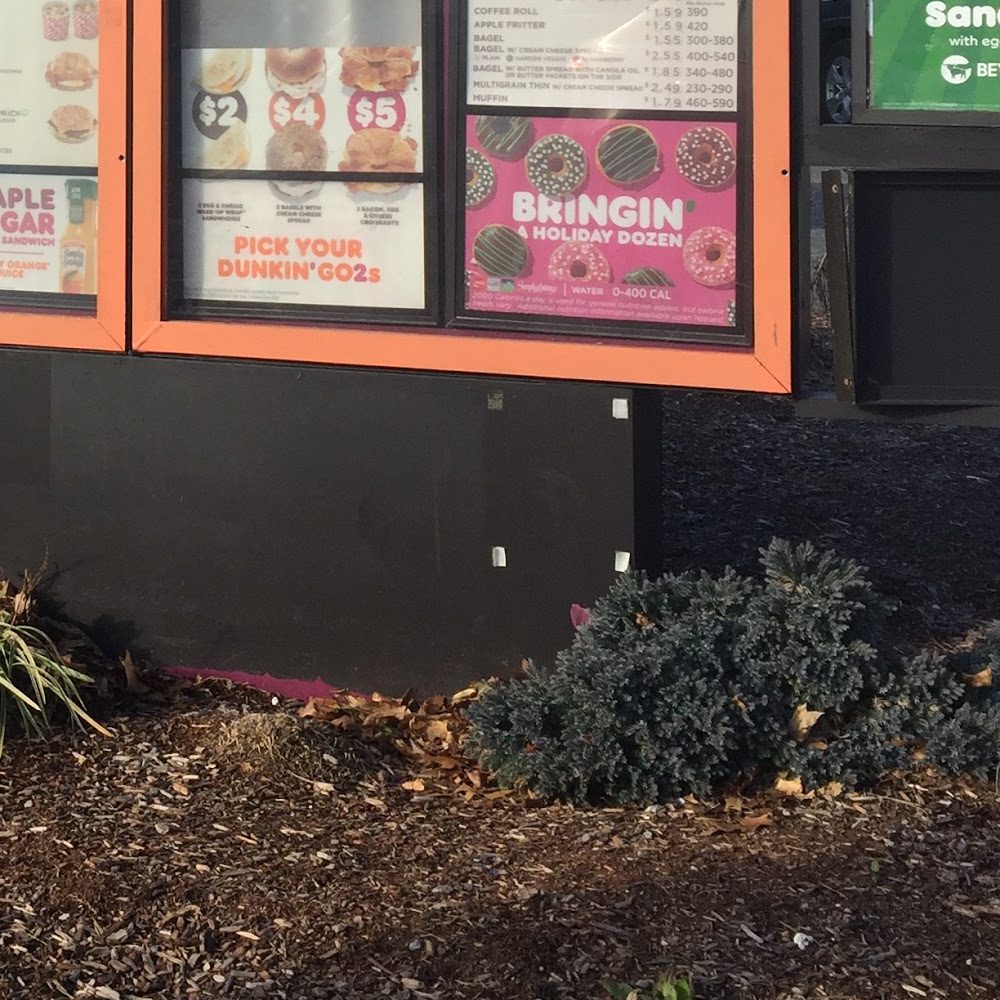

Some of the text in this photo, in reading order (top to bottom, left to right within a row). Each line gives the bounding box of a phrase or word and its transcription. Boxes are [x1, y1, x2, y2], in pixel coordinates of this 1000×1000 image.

[474, 7, 538, 15] COFFEE ROLL
[925, 0, 1000, 28] San
[474, 21, 545, 29] APPLE FRITTER
[474, 34, 504, 42] BAGEL
[949, 35, 978, 46] with
[473, 81, 732, 93] MULTIGRAIN THIN 230-290
[473, 94, 508, 102] MUFFIN
[686, 98, 733, 108] 460-590
[199, 96, 397, 127] $2 $4 $5
[2, 236, 55, 246] SANDWICH
[517, 226, 683, 247] A HOLIDAY DOZEN
[234, 236, 362, 258] PICK YOUR
[8, 260, 49, 270] ORANGE
[572, 286, 671, 300] WATER 0-400 CAL
